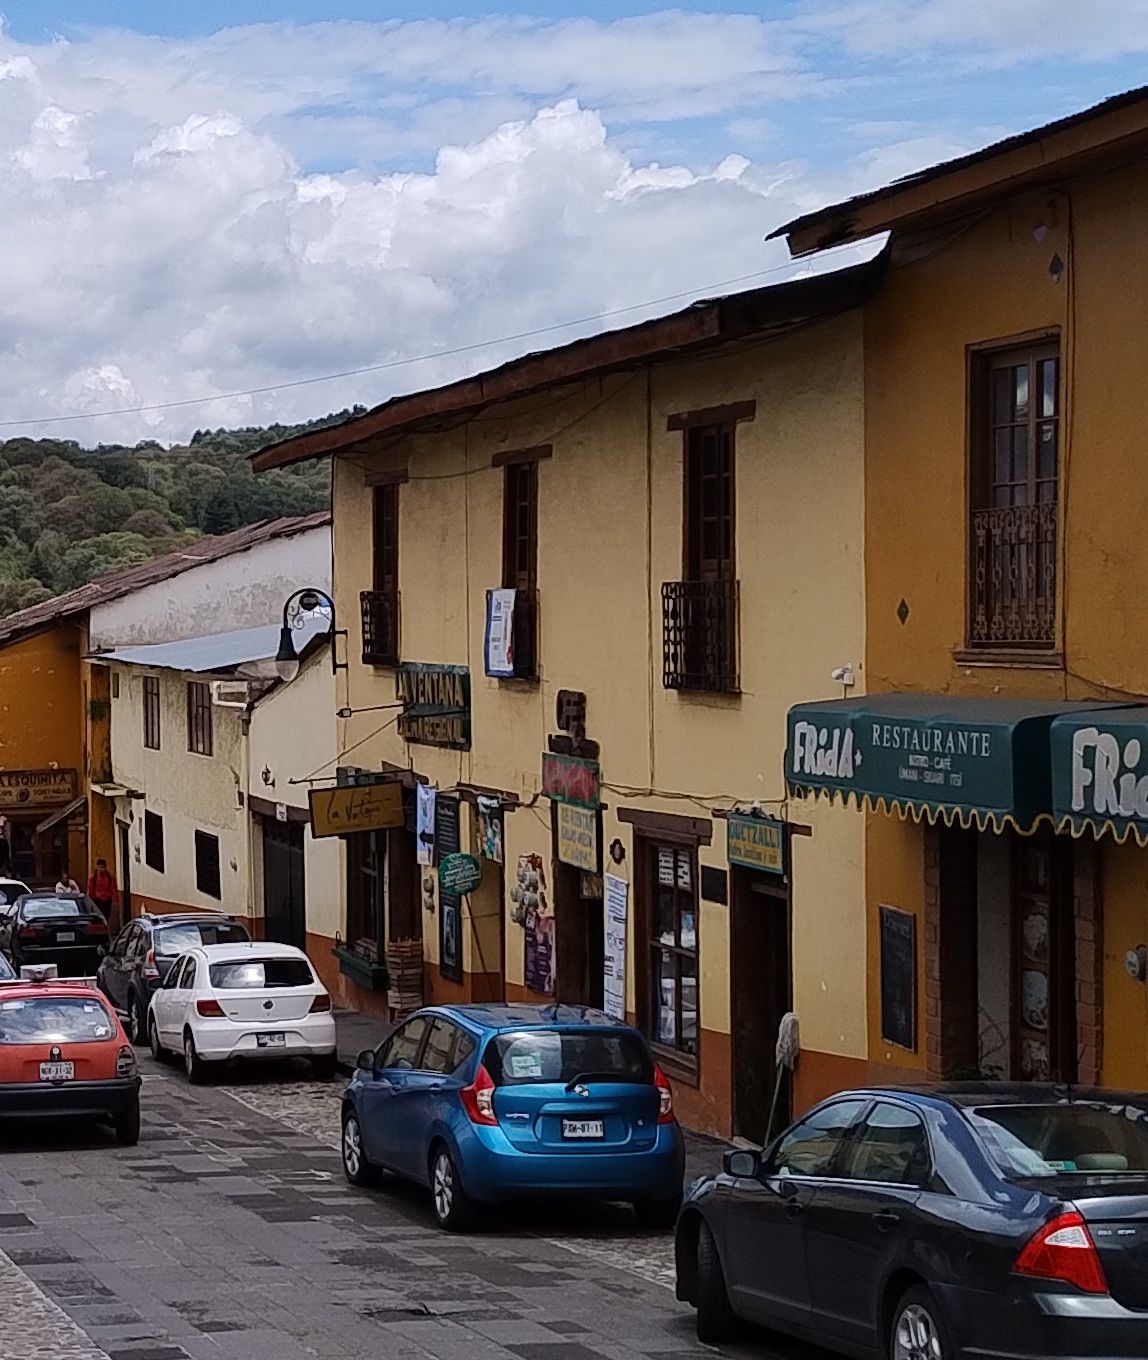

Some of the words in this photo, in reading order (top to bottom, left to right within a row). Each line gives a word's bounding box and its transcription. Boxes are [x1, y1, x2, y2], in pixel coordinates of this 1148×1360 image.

[410, 672, 464, 707] VENTANA
[872, 723, 991, 757] RESTAURANTE
[8, 774, 67, 786] ESQUINITA
